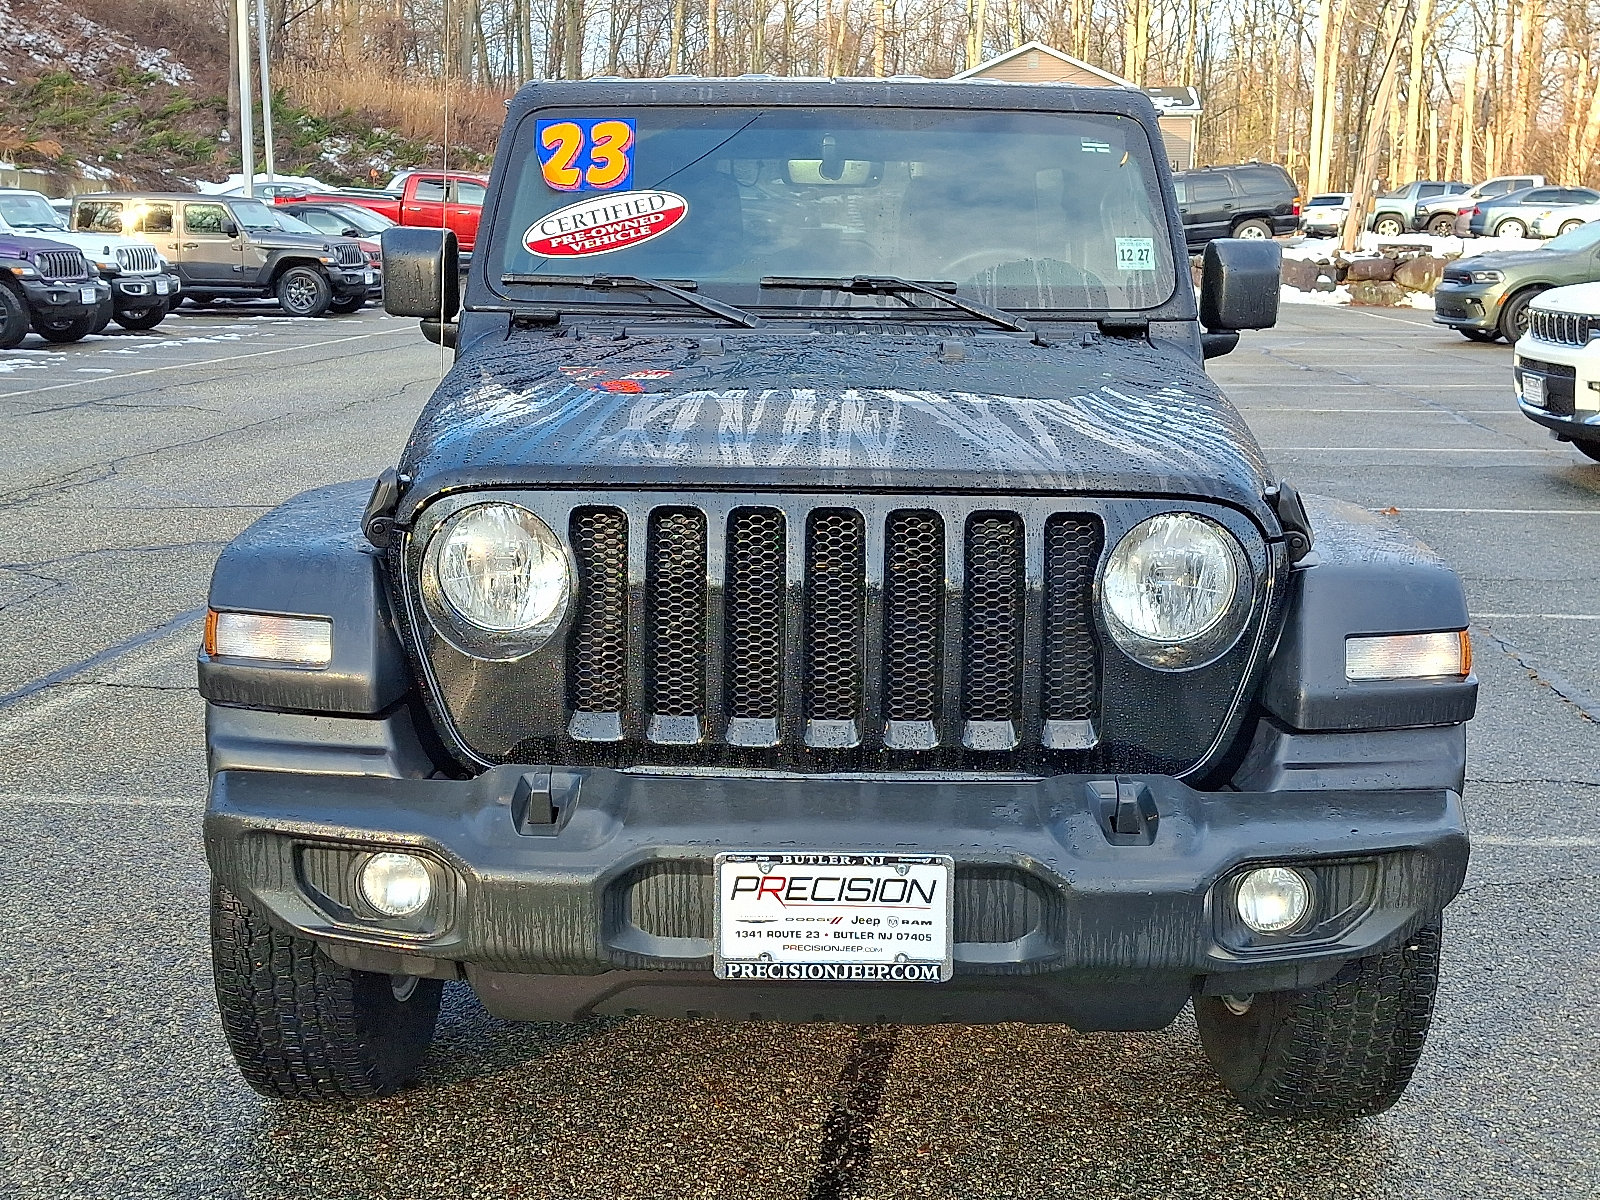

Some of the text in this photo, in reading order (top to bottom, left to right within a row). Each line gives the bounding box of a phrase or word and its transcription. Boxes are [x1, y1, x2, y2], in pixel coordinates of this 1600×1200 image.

[541, 121, 633, 190] 23
[540, 194, 666, 236] CERTIFIED
[549, 213, 665, 248] PRE-OWNED
[569, 226, 652, 252] VEHICLE
[1120, 248, 1149, 261] 12 27
[781, 855, 886, 866] BUTLER, NJ
[730, 876, 937, 904] PRECISION
[851, 915, 881, 927] Jeep
[735, 930, 932, 942] 1341 ROUTE 23 BUTLER NJ 07405
[726, 963, 940, 981] PRECISIONJEEP.COM
